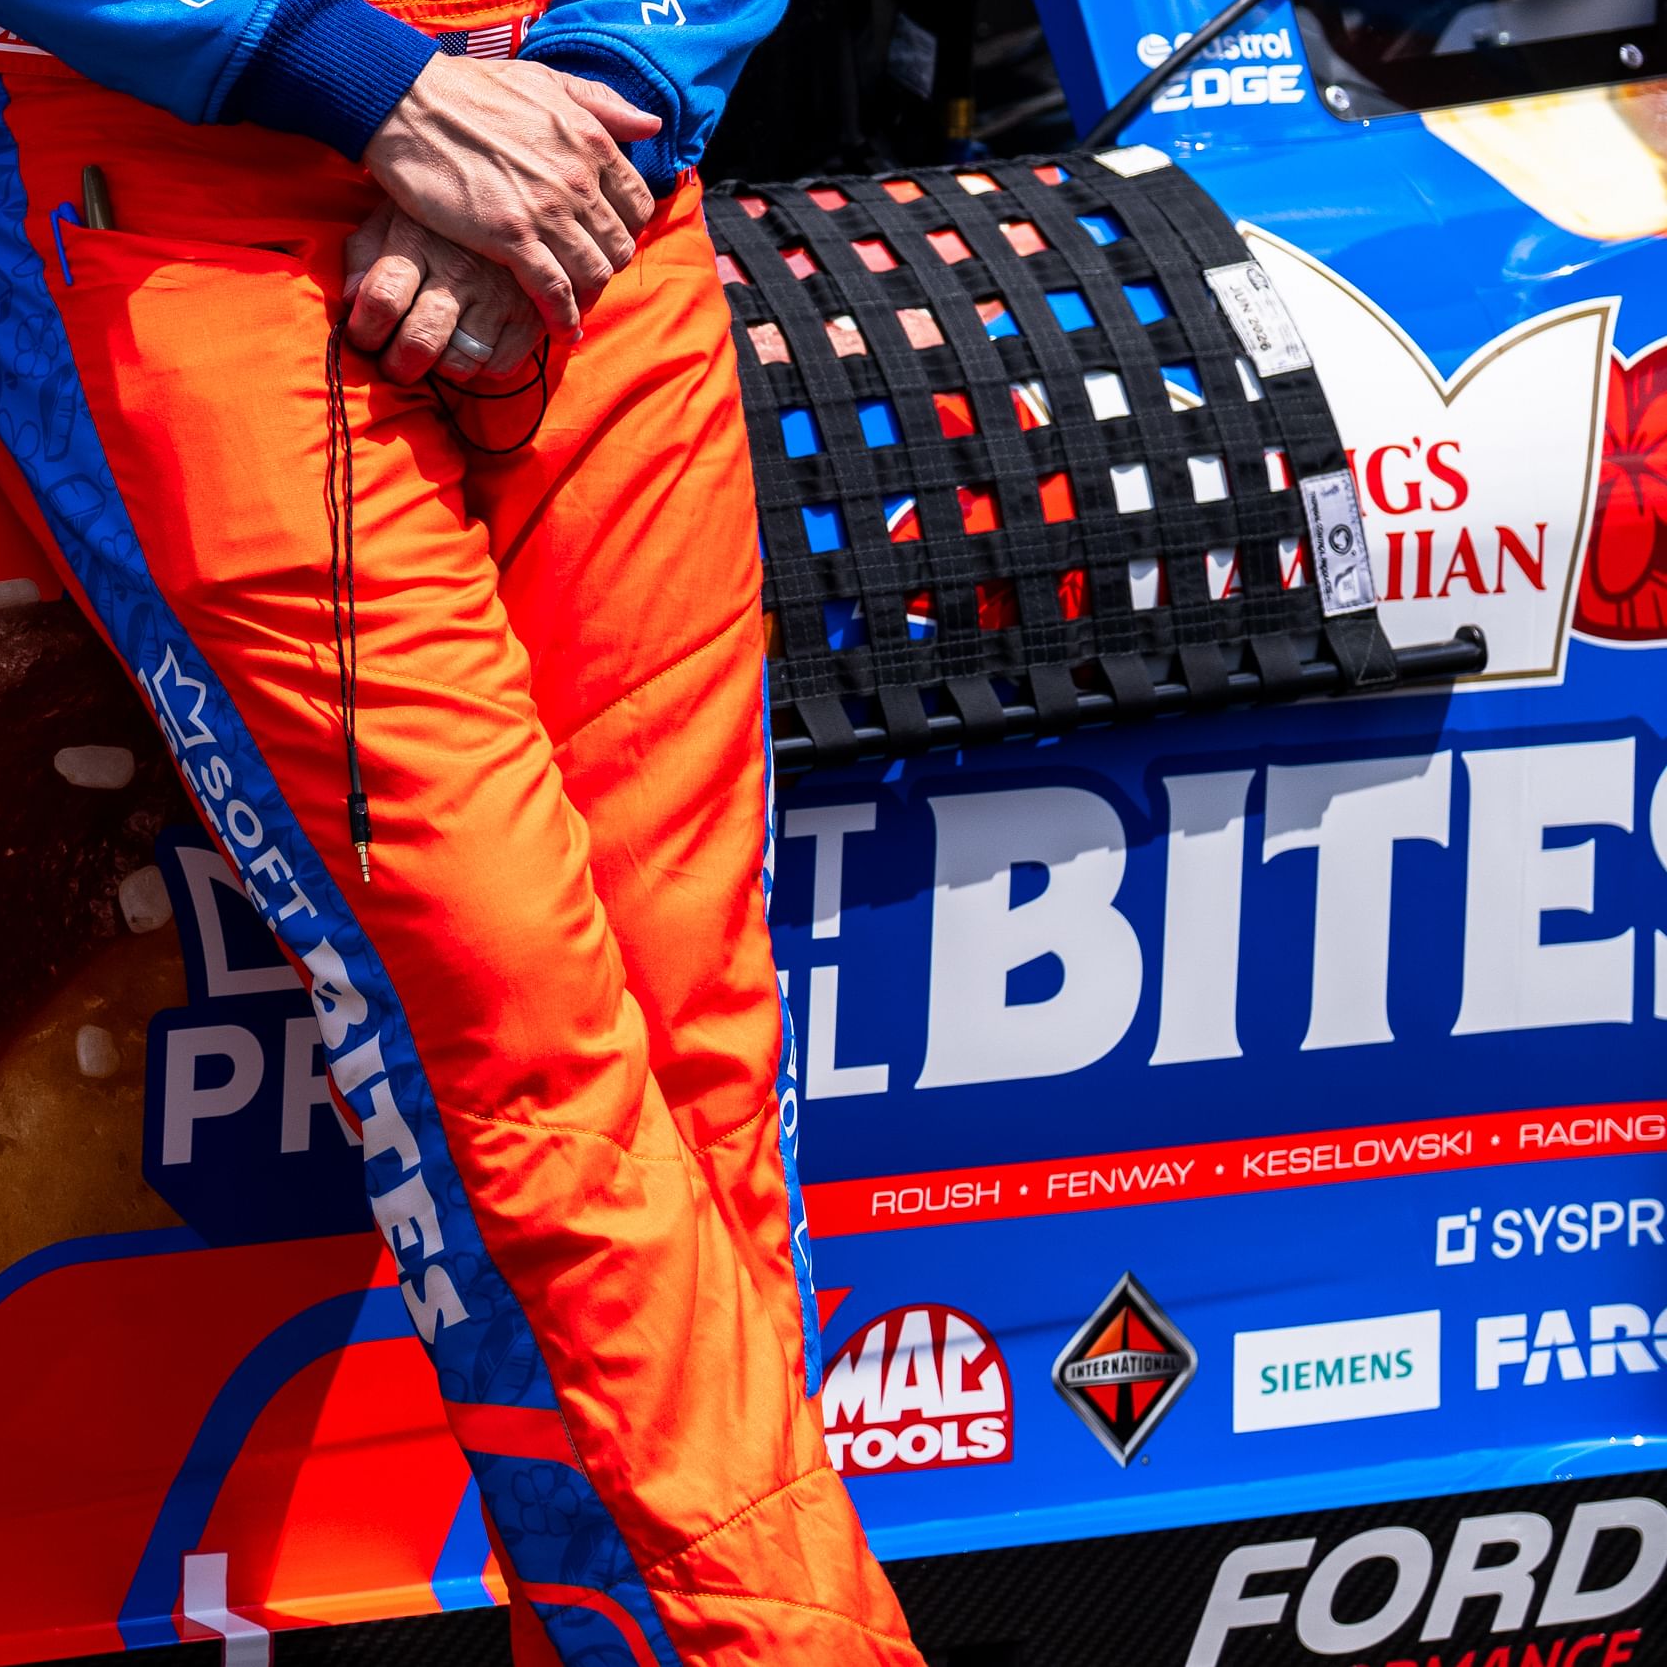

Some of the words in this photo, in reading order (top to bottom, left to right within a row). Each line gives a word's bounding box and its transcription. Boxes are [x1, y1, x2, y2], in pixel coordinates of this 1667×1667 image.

[1151, 64, 1306, 115] EDGE
[206, 755, 318, 922] SOFT
[914, 736, 1667, 1091] BITE
[302, 934, 471, 1346] BITES
[871, 1180, 1000, 1217] ROUSH
[1047, 1158, 1196, 1204] FENWAY
[1242, 1130, 1473, 1181] KESELOWSKI
[1518, 1114, 1667, 1151] RACING
[821, 1309, 1007, 1428] MAC
[1070, 1355, 1180, 1379] INTERNATIONAL
[1258, 1347, 1414, 1397] SIEMENS
[1475, 1302, 1667, 1391] FAR
[824, 1416, 1008, 1471] TOOLS
[1184, 1495, 1667, 1667] FORD
